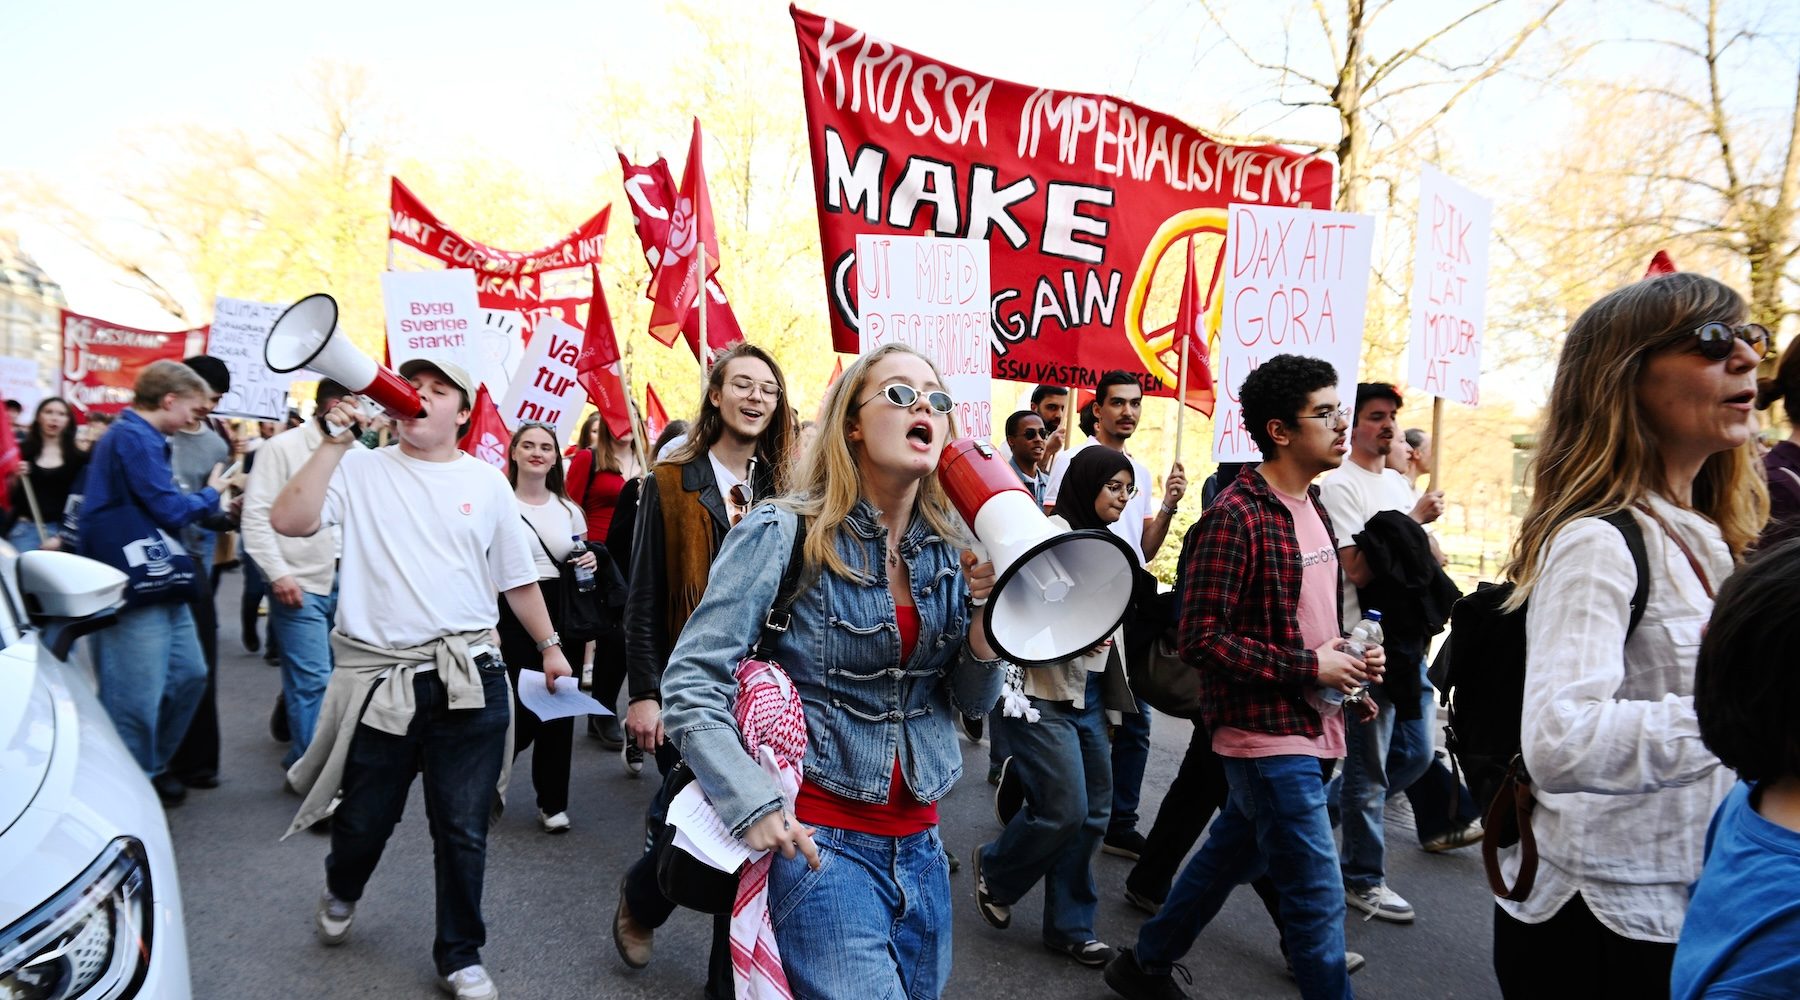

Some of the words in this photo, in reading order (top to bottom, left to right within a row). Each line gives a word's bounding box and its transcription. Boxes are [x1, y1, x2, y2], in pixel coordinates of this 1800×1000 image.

[816, 18, 994, 147] KROSSA
[1018, 86, 1309, 204] IMPERIALISMEN!
[824, 126, 1115, 265] MAKE
[1233, 208, 1295, 280] DAX
[1298, 220, 1356, 283] ATT
[1431, 193, 1472, 265] RIK
[578, 233, 606, 263] INT
[858, 240, 891, 299] UT
[915, 242, 978, 305] MED
[217, 303, 285, 321] KLIMATE
[401, 318, 468, 332] Sverige
[410, 302, 454, 316] Bygg
[1234, 284, 1335, 347] GÖRA
[408, 333, 466, 349] starkt!
[533, 366, 576, 398] tur
[996, 360, 1031, 379] SSU
[1036, 362, 1097, 387] VÄSTRA
[1424, 358, 1451, 392] AT
